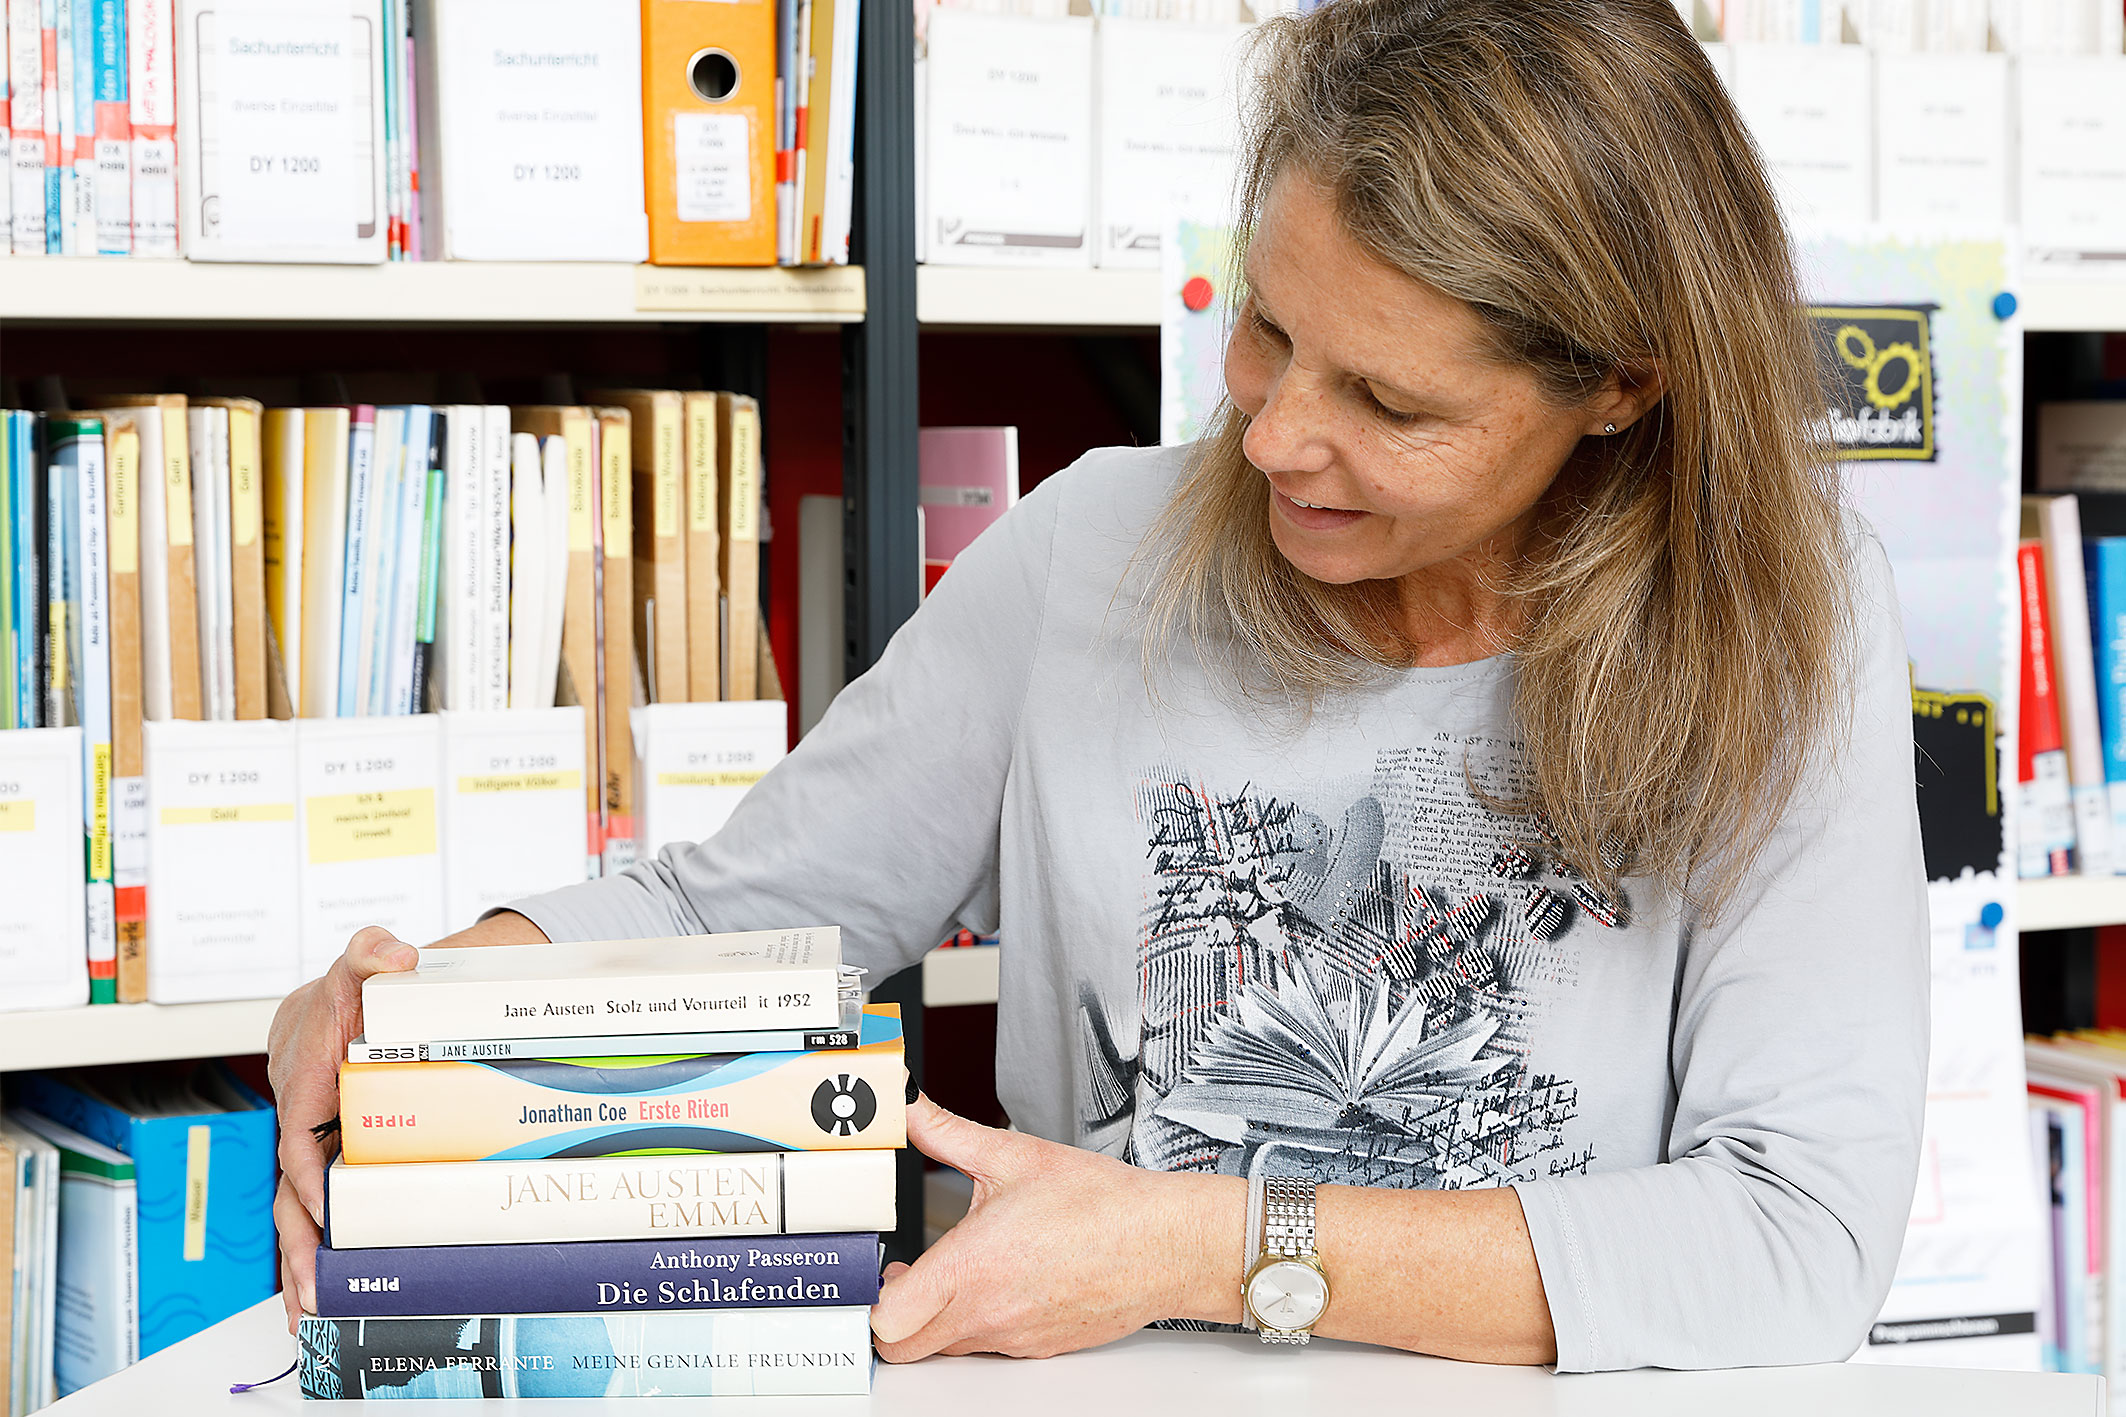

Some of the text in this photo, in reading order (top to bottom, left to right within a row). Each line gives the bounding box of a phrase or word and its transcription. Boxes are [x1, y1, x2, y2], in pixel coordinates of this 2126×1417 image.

[229, 37, 340, 56] Sachunterricht
[250, 155, 320, 174] DY 1200
[514, 163, 581, 181] DY 1200
[325, 760, 394, 774] DY 1200
[188, 772, 259, 784] DY 1200
[504, 993, 811, 1018] Jane Austen Stolz und Vorurteil it 1952
[810, 1034, 848, 1045] rm 528
[441, 1043, 512, 1057] JANE AUSTEN
[362, 1114, 416, 1128] PIPER
[519, 1098, 729, 1125] Jonathan Coe Erste Riten
[500, 1166, 768, 1212] JANE AUSTEN
[648, 1199, 770, 1229] EMMA
[650, 1248, 840, 1272] Anthony Passeron
[347, 1276, 400, 1293] PIPER
[597, 1276, 841, 1305] Die Schlafenden
[370, 1352, 857, 1372] ELENA FERRANTE MEINE GENIALE FREUNDIN
